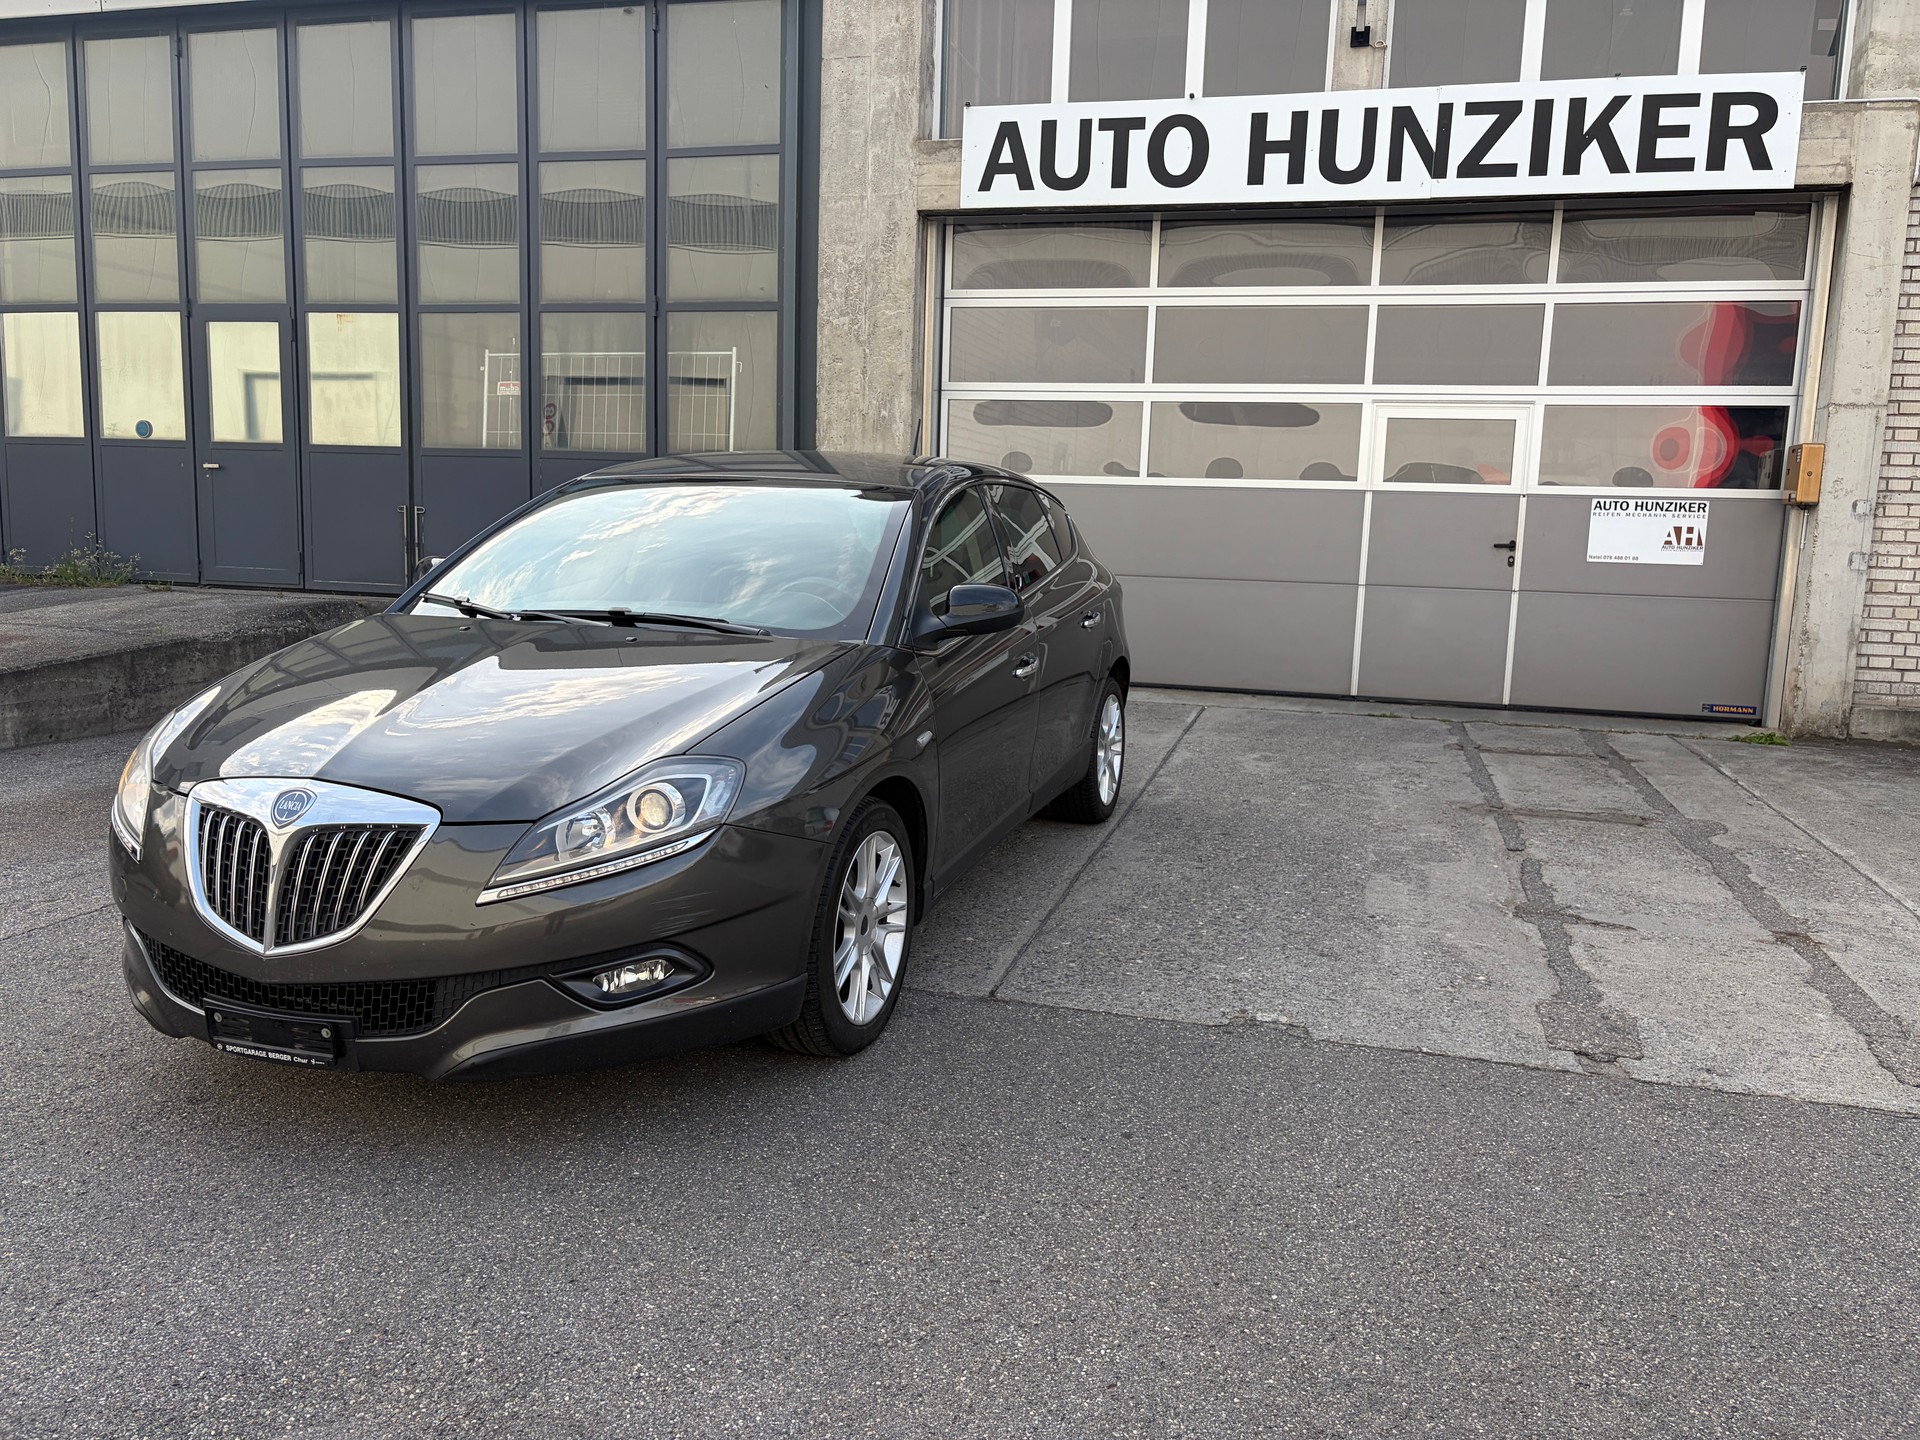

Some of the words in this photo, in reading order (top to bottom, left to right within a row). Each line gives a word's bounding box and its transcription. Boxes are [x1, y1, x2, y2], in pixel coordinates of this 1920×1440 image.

[976, 113, 1210, 193] AUTO
[1246, 91, 1780, 187] HUNZIKER
[1593, 500, 1630, 511] AUTO
[1634, 501, 1707, 513] HUNZIKER
[279, 800, 302, 811] LANCIA
[226, 1045, 268, 1057] SPORTGARAGE
[269, 1053, 291, 1061] BERGER
[293, 1056, 308, 1064] Chur
